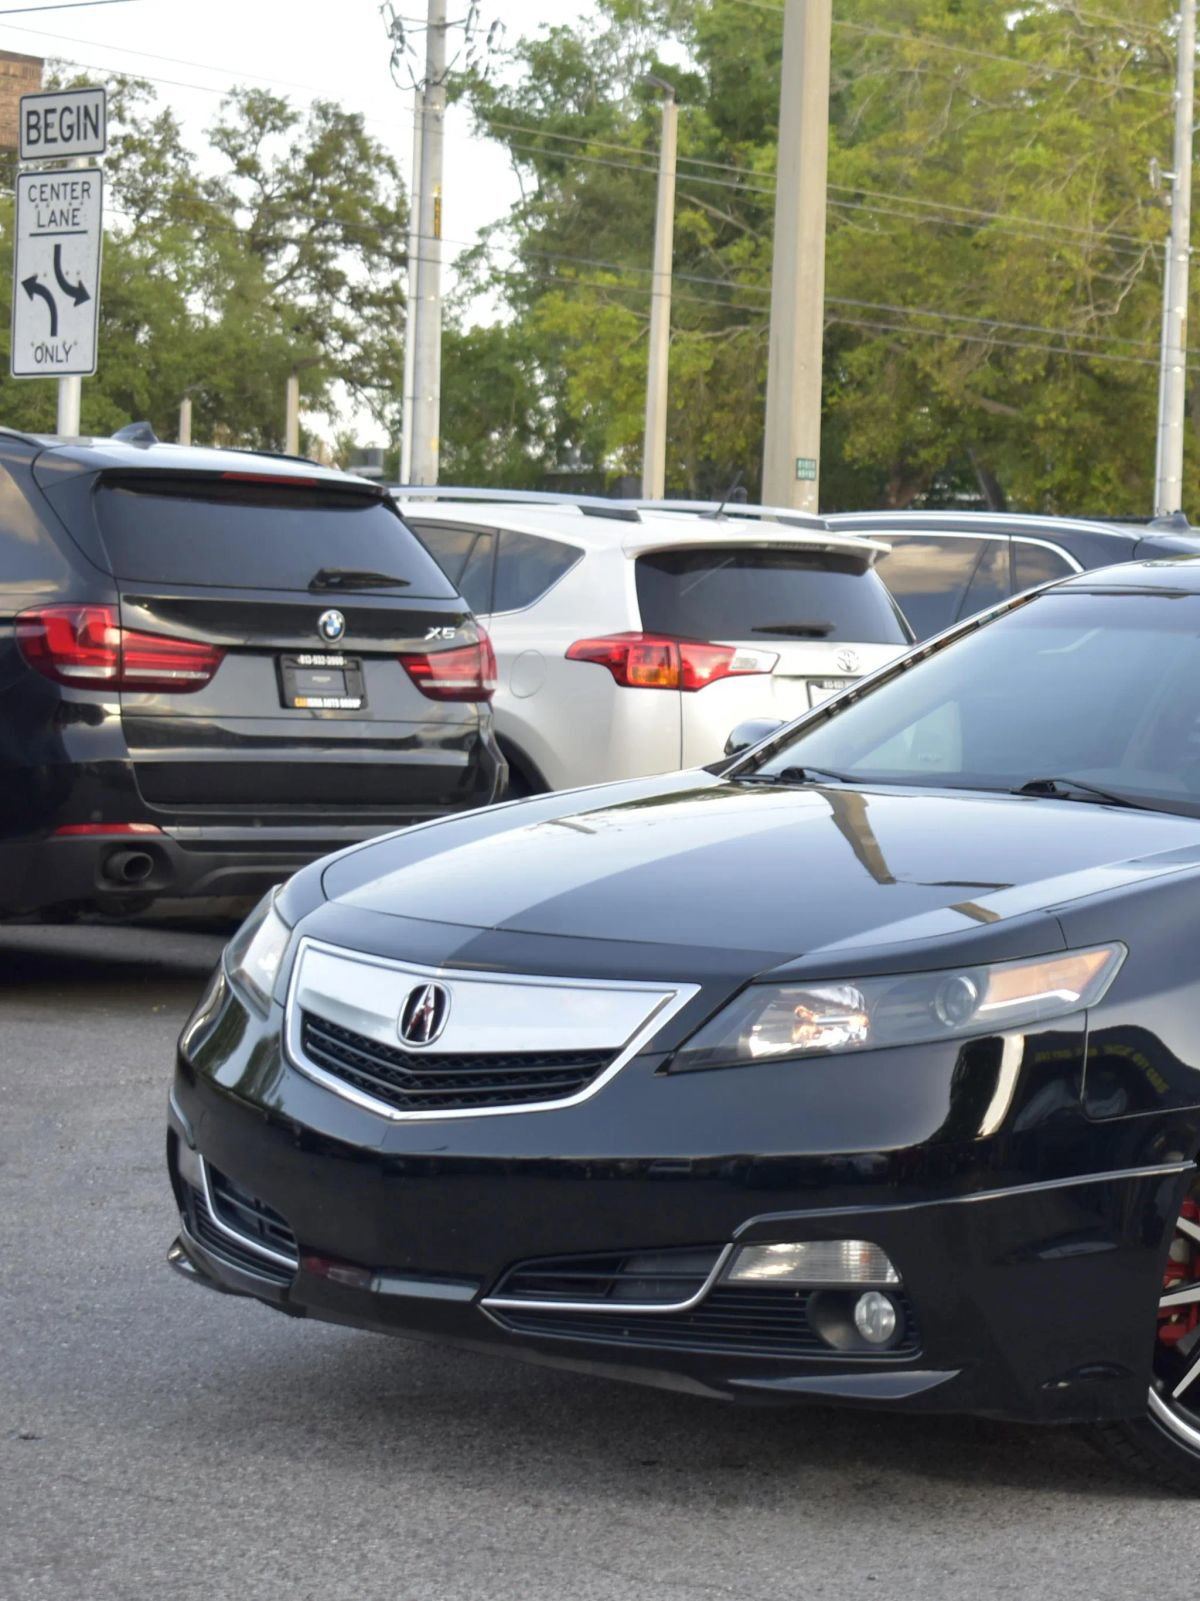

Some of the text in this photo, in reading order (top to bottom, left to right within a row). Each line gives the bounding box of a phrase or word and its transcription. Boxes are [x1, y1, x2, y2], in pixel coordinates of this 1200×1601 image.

[26, 103, 99, 146] BEGIN
[27, 181, 91, 203] CENTER
[37, 207, 81, 228] LANE
[34, 344, 72, 364] ONLY
[424, 626, 456, 640] X5
